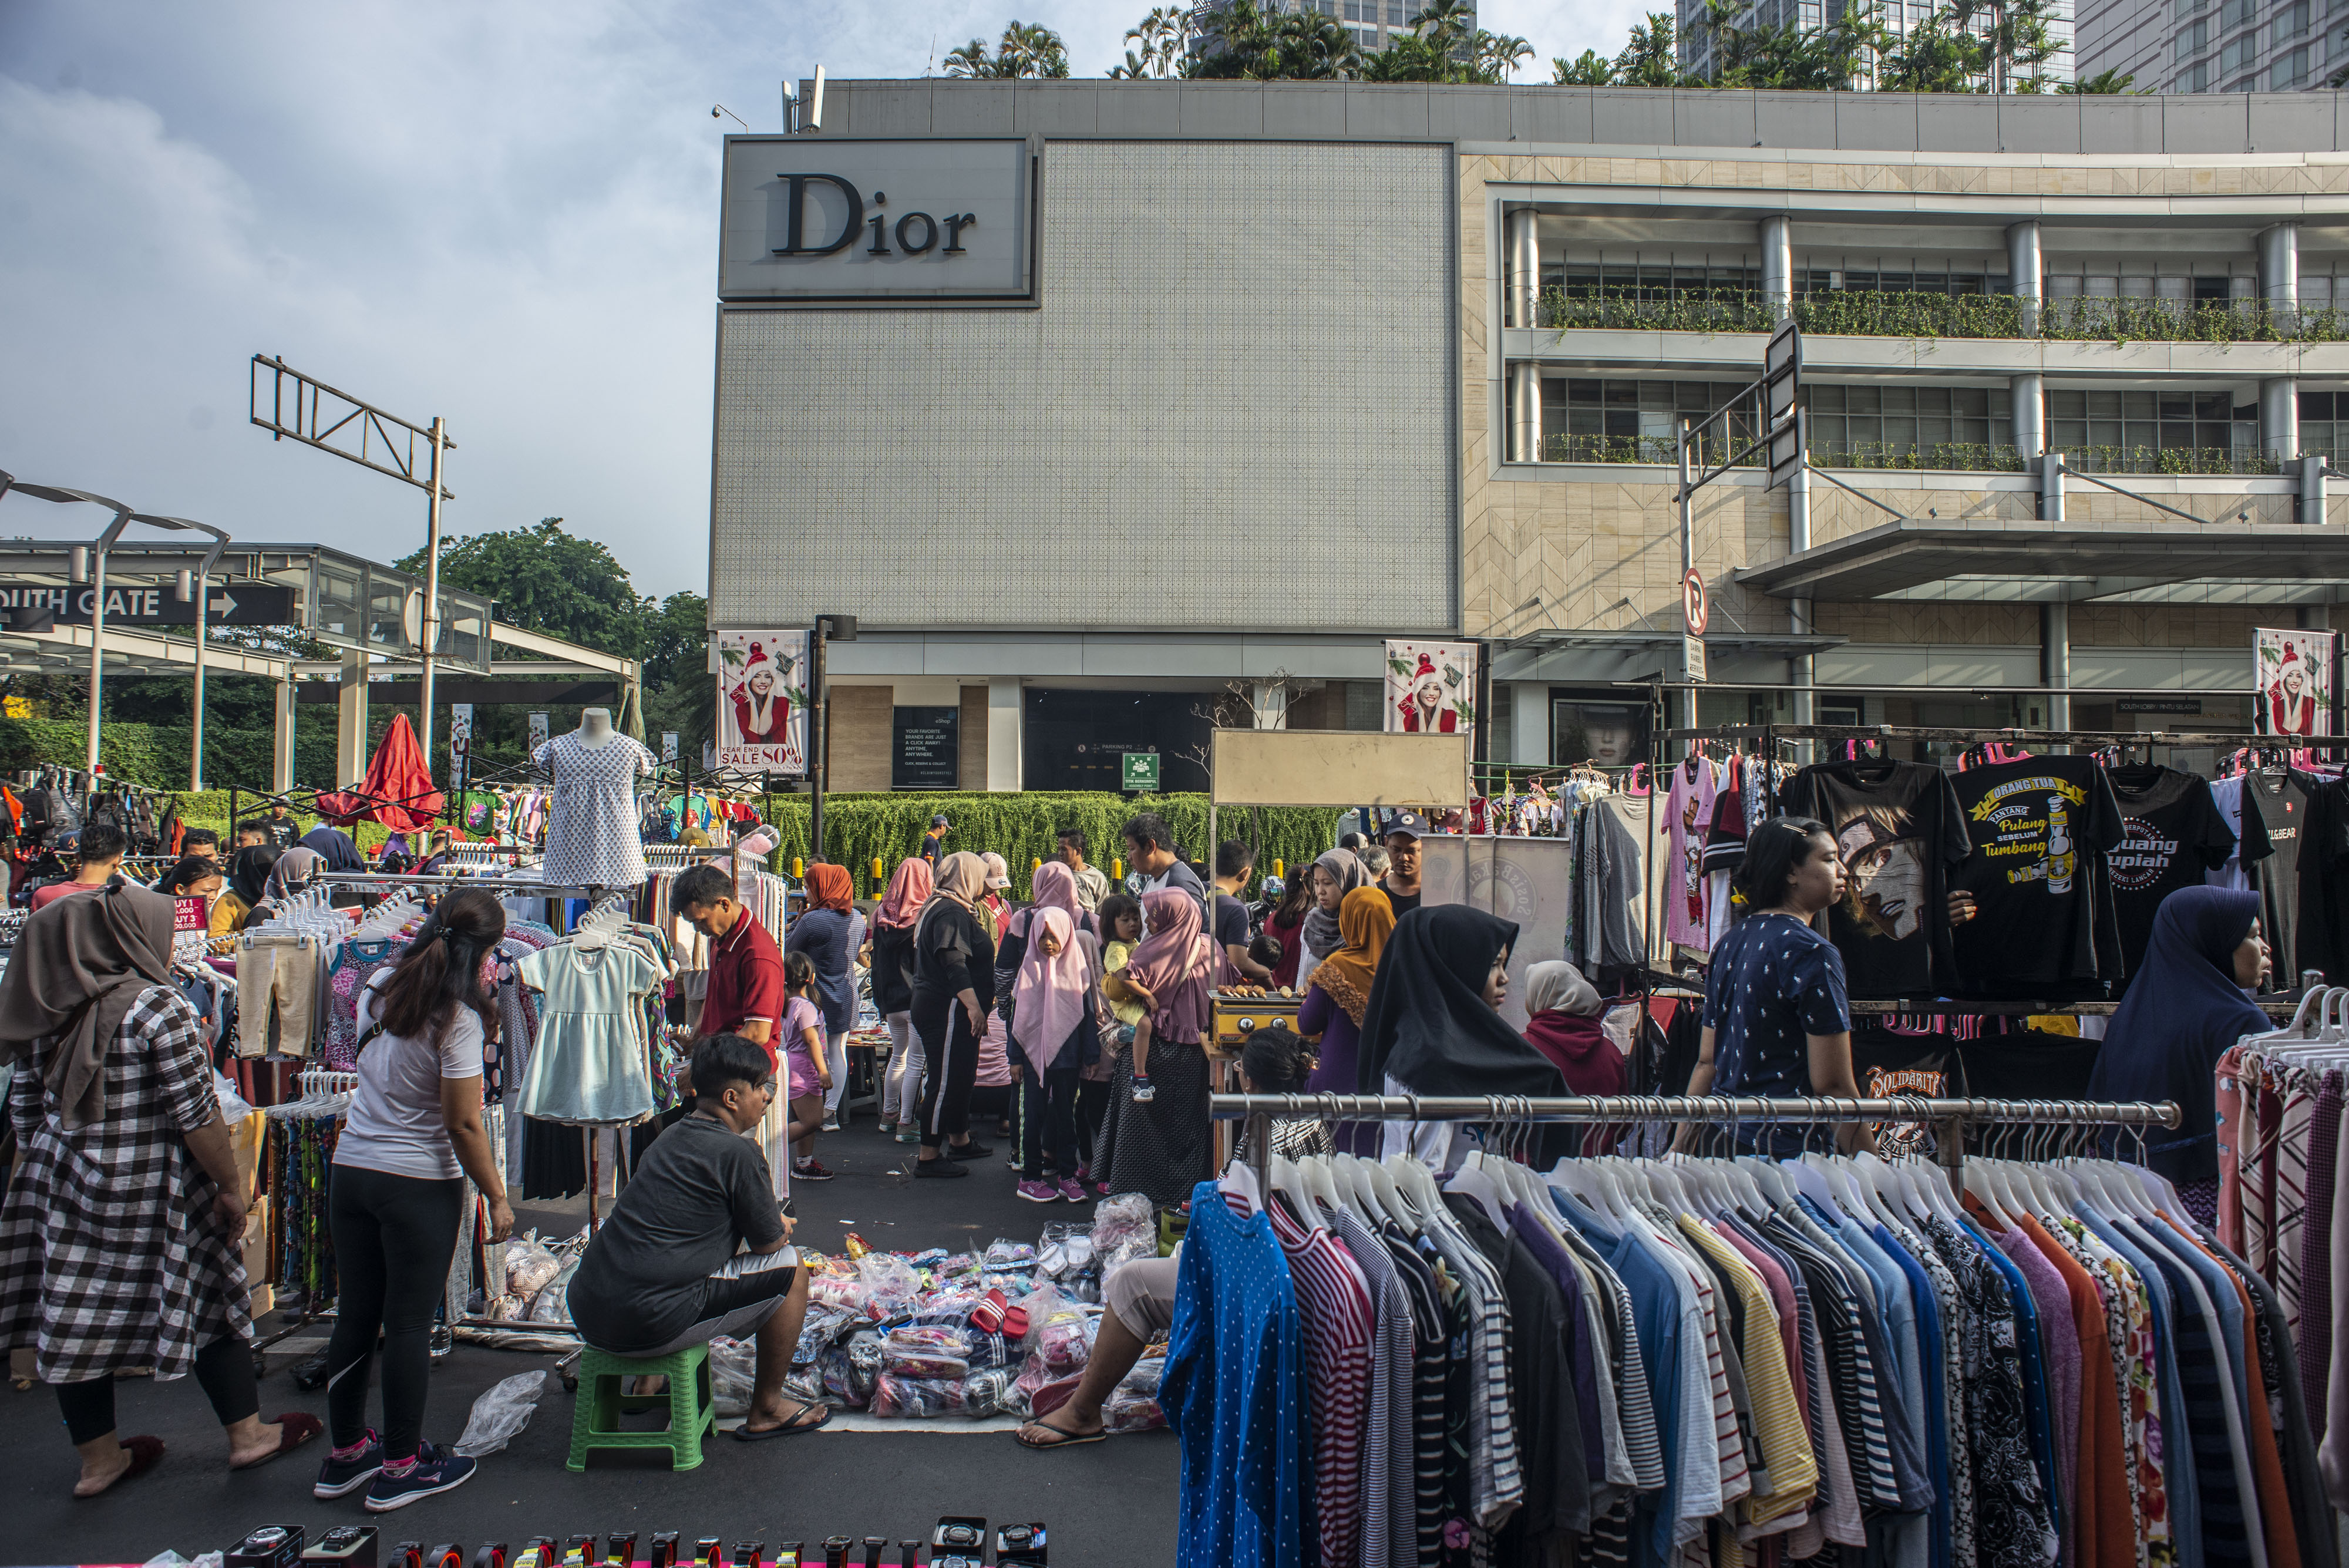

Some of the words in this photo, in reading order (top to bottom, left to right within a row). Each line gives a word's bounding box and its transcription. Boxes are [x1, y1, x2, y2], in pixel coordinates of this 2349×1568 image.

[772, 174, 975, 254] Dior
[78, 590, 160, 615] GATE
[722, 753, 759, 764] SALE
[762, 747, 802, 764] 80%
[1993, 779, 2031, 799] ORANG
[2032, 778, 2057, 789] TUA
[1990, 807, 2028, 822] PANTANG
[1999, 819, 2048, 833] Pulang
[2268, 827, 2296, 840] LL&BEAR
[1997, 831, 2038, 842] SEBELUM
[1981, 840, 2048, 858] Tumbang
[2108, 854, 2170, 869] upiah
[2131, 869, 2155, 883] LANCAR
[174, 899, 187, 907] UY
